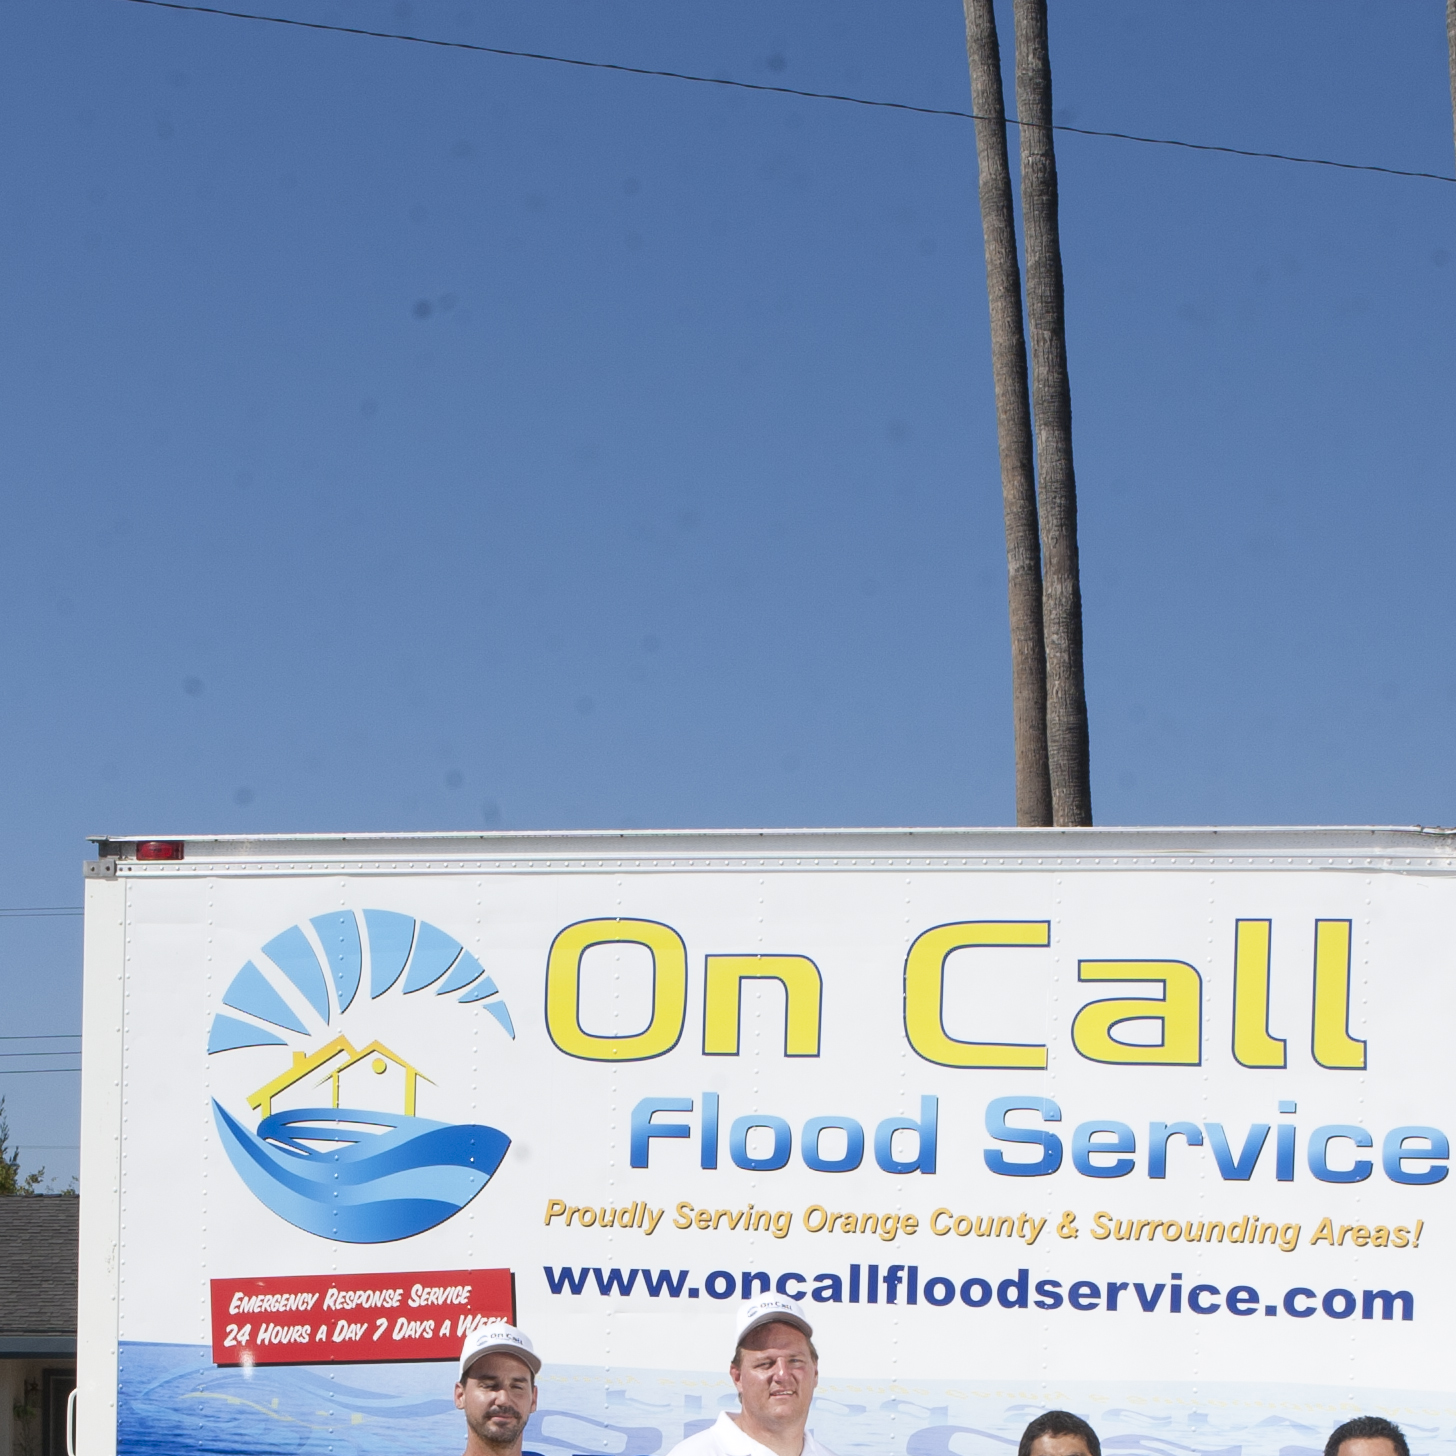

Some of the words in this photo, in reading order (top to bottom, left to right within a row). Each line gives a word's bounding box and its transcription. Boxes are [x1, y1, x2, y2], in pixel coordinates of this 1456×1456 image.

[544, 916, 823, 1062] On
[904, 917, 1368, 1070] Call
[629, 1091, 939, 1176] Flood
[982, 1096, 1450, 1186] Service
[544, 1198, 665, 1235] Proudly
[673, 1201, 793, 1239] Serving
[803, 1204, 919, 1242] Orange
[929, 1207, 1047, 1246] County
[1055, 1210, 1080, 1241] &
[1090, 1211, 1301, 1253] Surrounding
[1308, 1217, 1425, 1250] Areas!
[543, 1263, 1415, 1321] www.oncallfloodservice.com
[223, 1323, 252, 1348] 24
[372, 1317, 388, 1341] 7
